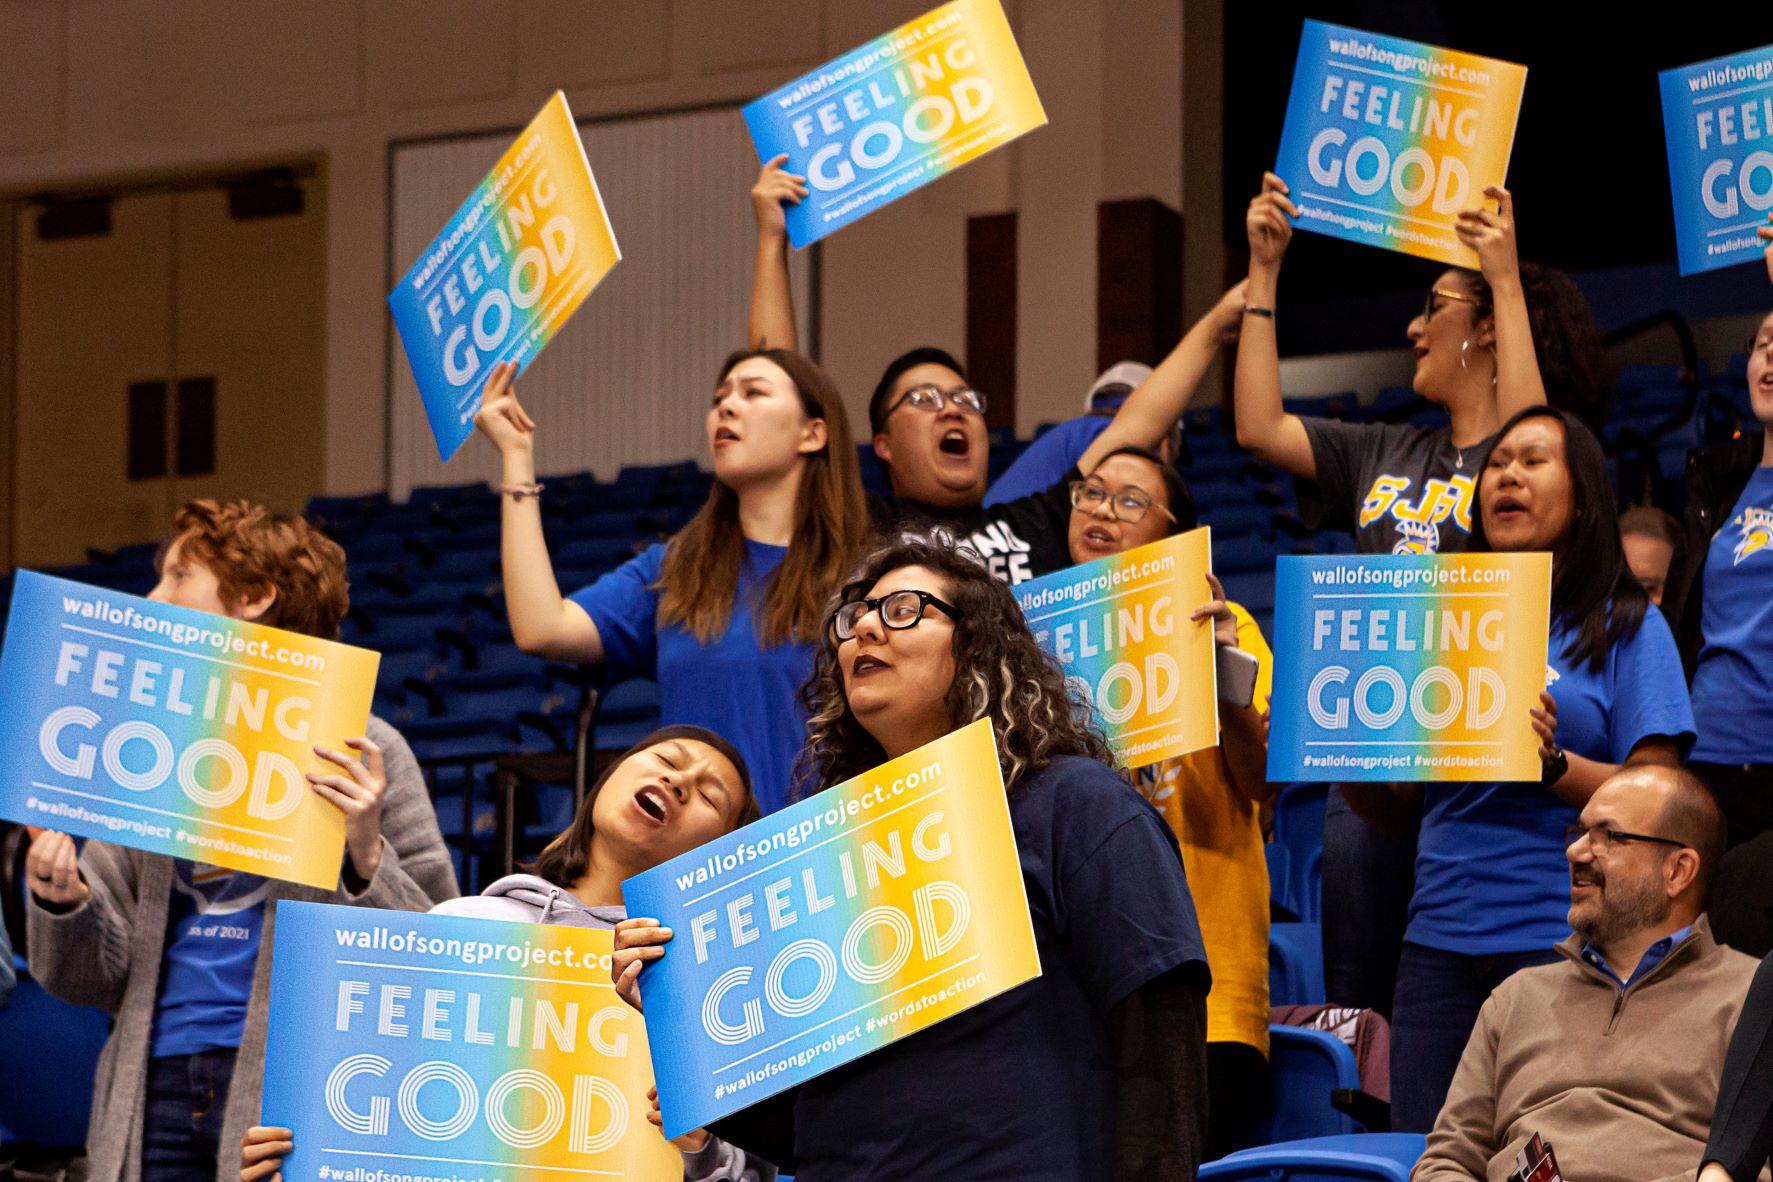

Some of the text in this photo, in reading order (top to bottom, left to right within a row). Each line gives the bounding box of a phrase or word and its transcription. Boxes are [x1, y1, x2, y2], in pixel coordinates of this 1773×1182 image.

[778, 11, 962, 109] wallofsongproject.com
[792, 39, 976, 148] FEELING
[1329, 38, 1490, 86] wallofsongproject.com
[1689, 59, 1773, 93] wallofsongp
[807, 77, 994, 191] GOOD
[1320, 75, 1480, 147] FEELING
[1307, 127, 1470, 215] GOOD
[413, 134, 543, 290] wallofsongproject.com
[426, 168, 556, 336] FEELING
[443, 215, 577, 386] GOOD
[1018, 555, 1174, 610] llofsongproject.com
[1312, 565, 1511, 588] wallofsongproject.com
[63, 596, 326, 671] wallofsongproject.com
[1035, 596, 1174, 664] ELING
[1313, 609, 1505, 651] FEELING
[54, 641, 313, 742] FEELING
[1064, 652, 1180, 725] OD
[1307, 665, 1506, 730] GOOD
[39, 705, 304, 820] GOOD
[1303, 755, 1504, 769] #wallofsongproject #wordstoaction
[27, 797, 292, 865] #wallofsongproject #wordstoaction
[676, 759, 941, 892] wallofsongproject.com
[690, 811, 952, 964] FEELING
[219, 925, 250, 940] 2021
[335, 928, 613, 969] wallofsongproject.co
[701, 880, 971, 1046] GOOD
[336, 980, 629, 1057] FEELING
[714, 970, 986, 1100] #wallofsongproject #wordstoaction
[325, 1053, 630, 1154] GOOD
